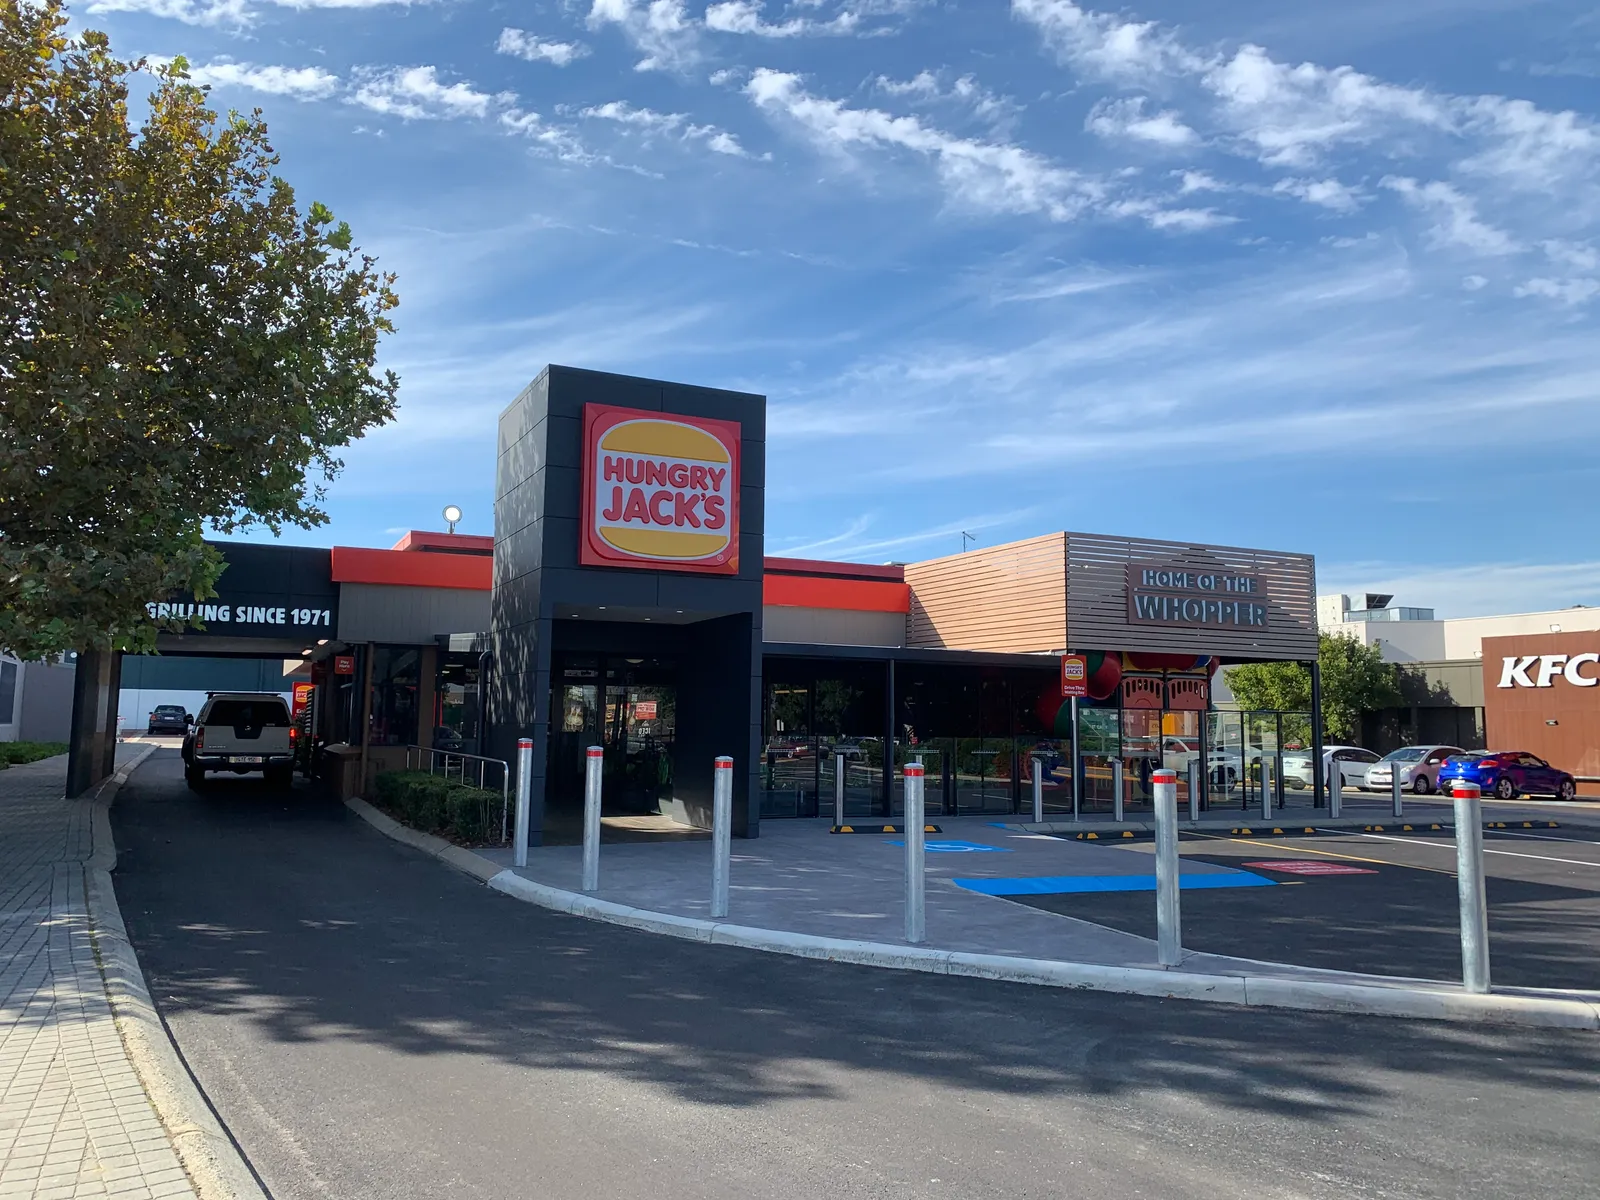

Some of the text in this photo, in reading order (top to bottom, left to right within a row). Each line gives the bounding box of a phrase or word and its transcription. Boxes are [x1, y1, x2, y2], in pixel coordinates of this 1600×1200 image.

[604, 456, 726, 492] HUNGRY
[603, 486, 726, 529] JACK'S
[1142, 569, 1257, 593] HOME OF THE
[235, 606, 286, 624] SINCE
[290, 608, 331, 626] 1971
[1134, 595, 1267, 626] WHOPPER
[1497, 652, 1600, 688] KFC
